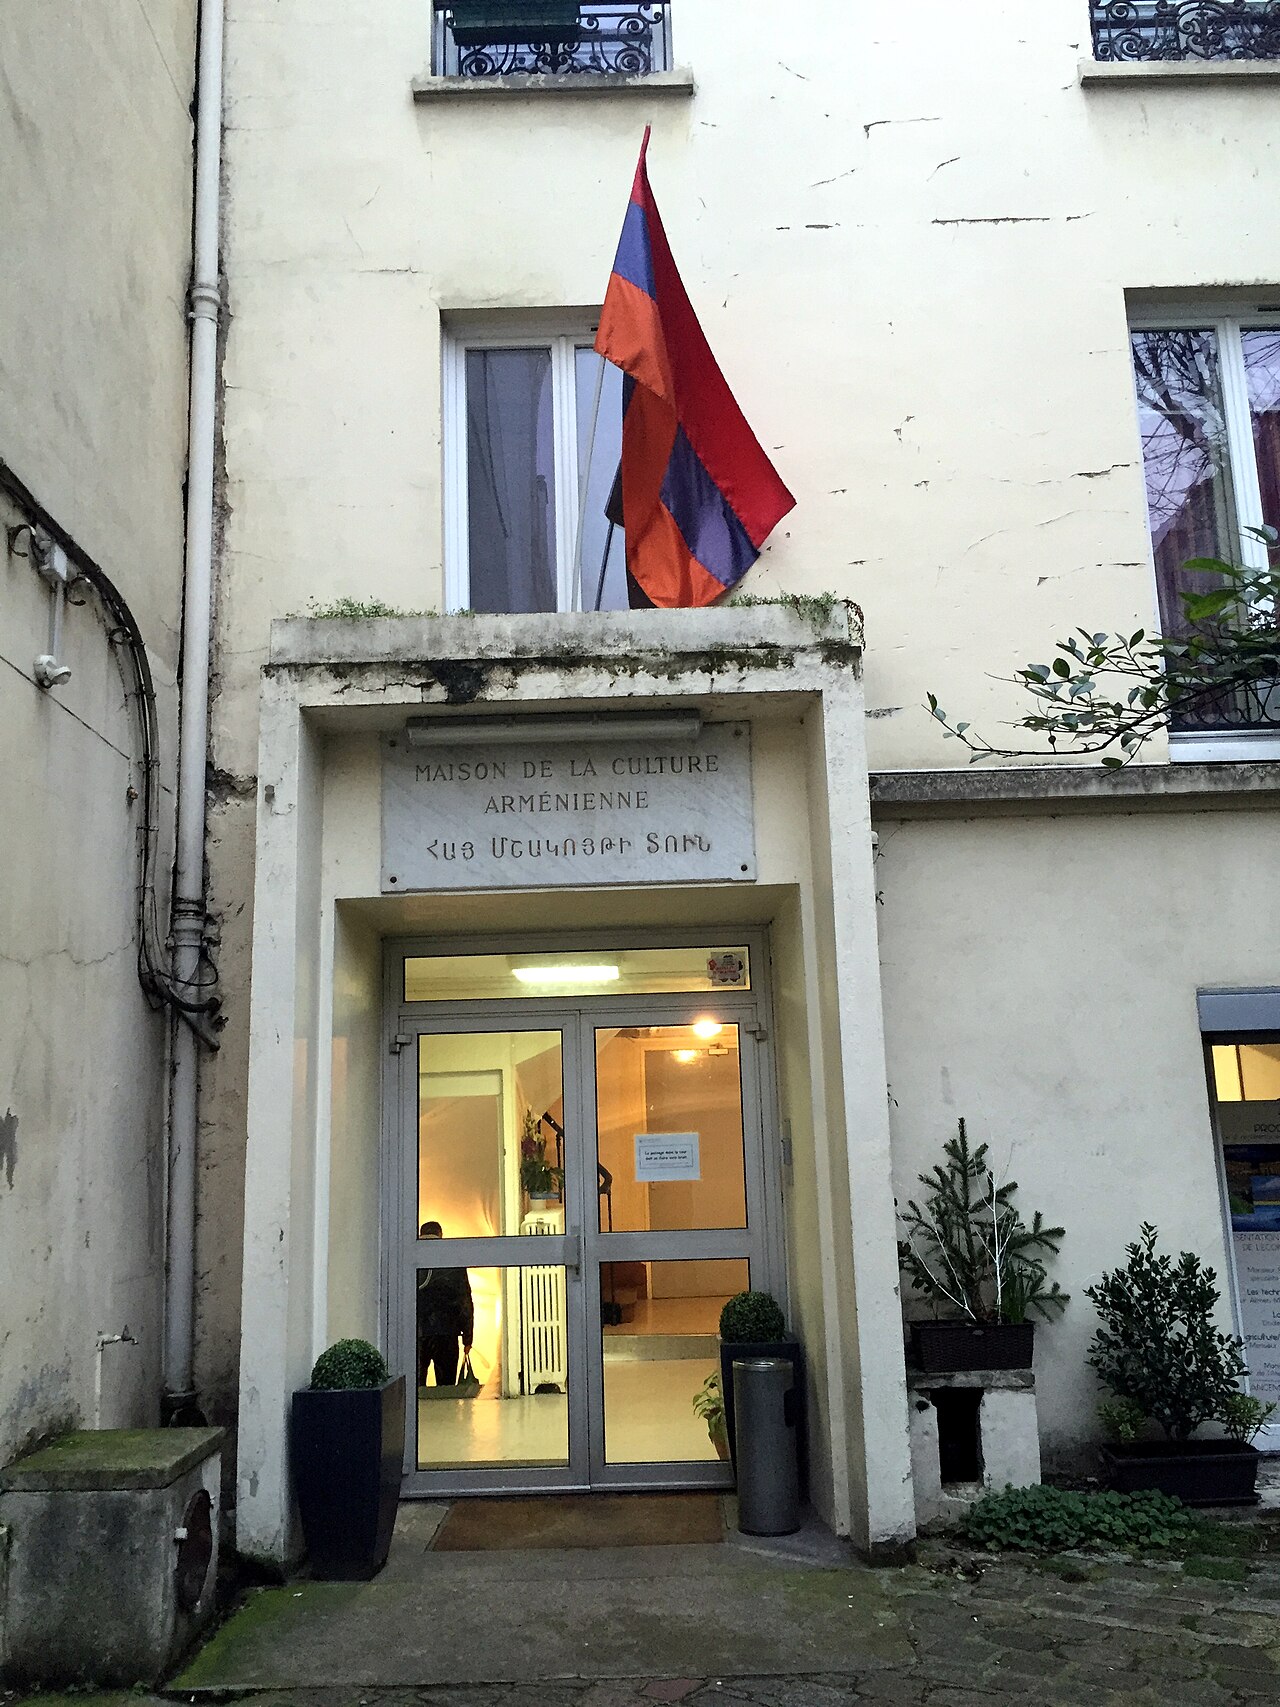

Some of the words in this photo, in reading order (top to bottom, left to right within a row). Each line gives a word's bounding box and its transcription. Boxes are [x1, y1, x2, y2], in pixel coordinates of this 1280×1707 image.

[415, 761, 506, 782] MAISON
[523, 760, 553, 779] DE
[570, 758, 598, 777] LA
[612, 754, 719, 776] CULTURE
[484, 791, 649, 814] ARMÉNIENNE
[426, 839, 475, 861] ՀԱՅ
[492, 836, 632, 859] ՄՇԱԿՈՅԹԻ
[646, 832, 710, 854] ՏՈՒՆ
